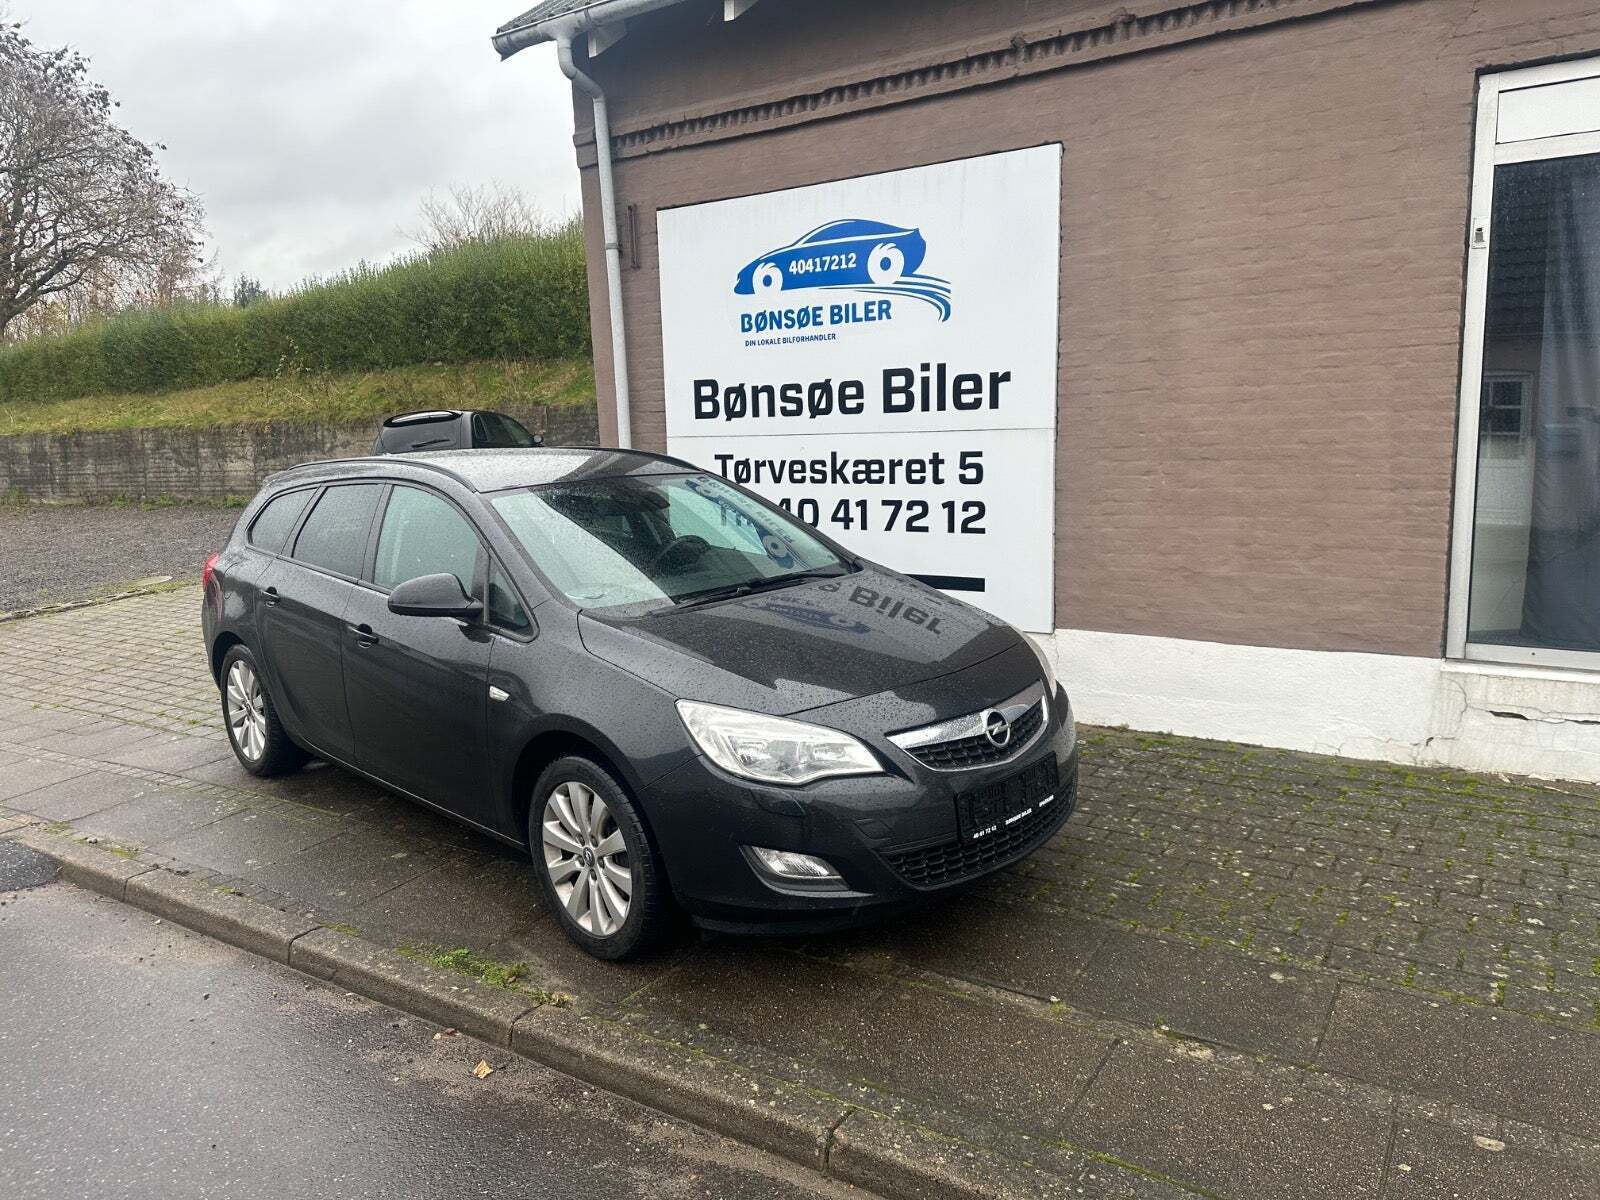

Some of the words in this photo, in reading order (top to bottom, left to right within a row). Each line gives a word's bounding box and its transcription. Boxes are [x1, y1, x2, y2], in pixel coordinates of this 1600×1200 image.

[788, 252, 857, 275] 40417212
[740, 306, 824, 334] BØNSØE
[829, 299, 892, 325] BILER
[744, 339, 757, 347] DIN
[757, 337, 781, 346] LOKALE
[782, 332, 837, 345] BILFORHANDLER
[693, 378, 865, 422] Bønsøe
[882, 362, 1012, 414] Biler
[714, 451, 945, 486] Tørveskæret
[958, 450, 984, 485] 5
[830, 498, 868, 531] 41
[881, 499, 929, 533] 72
[941, 500, 986, 535] 12
